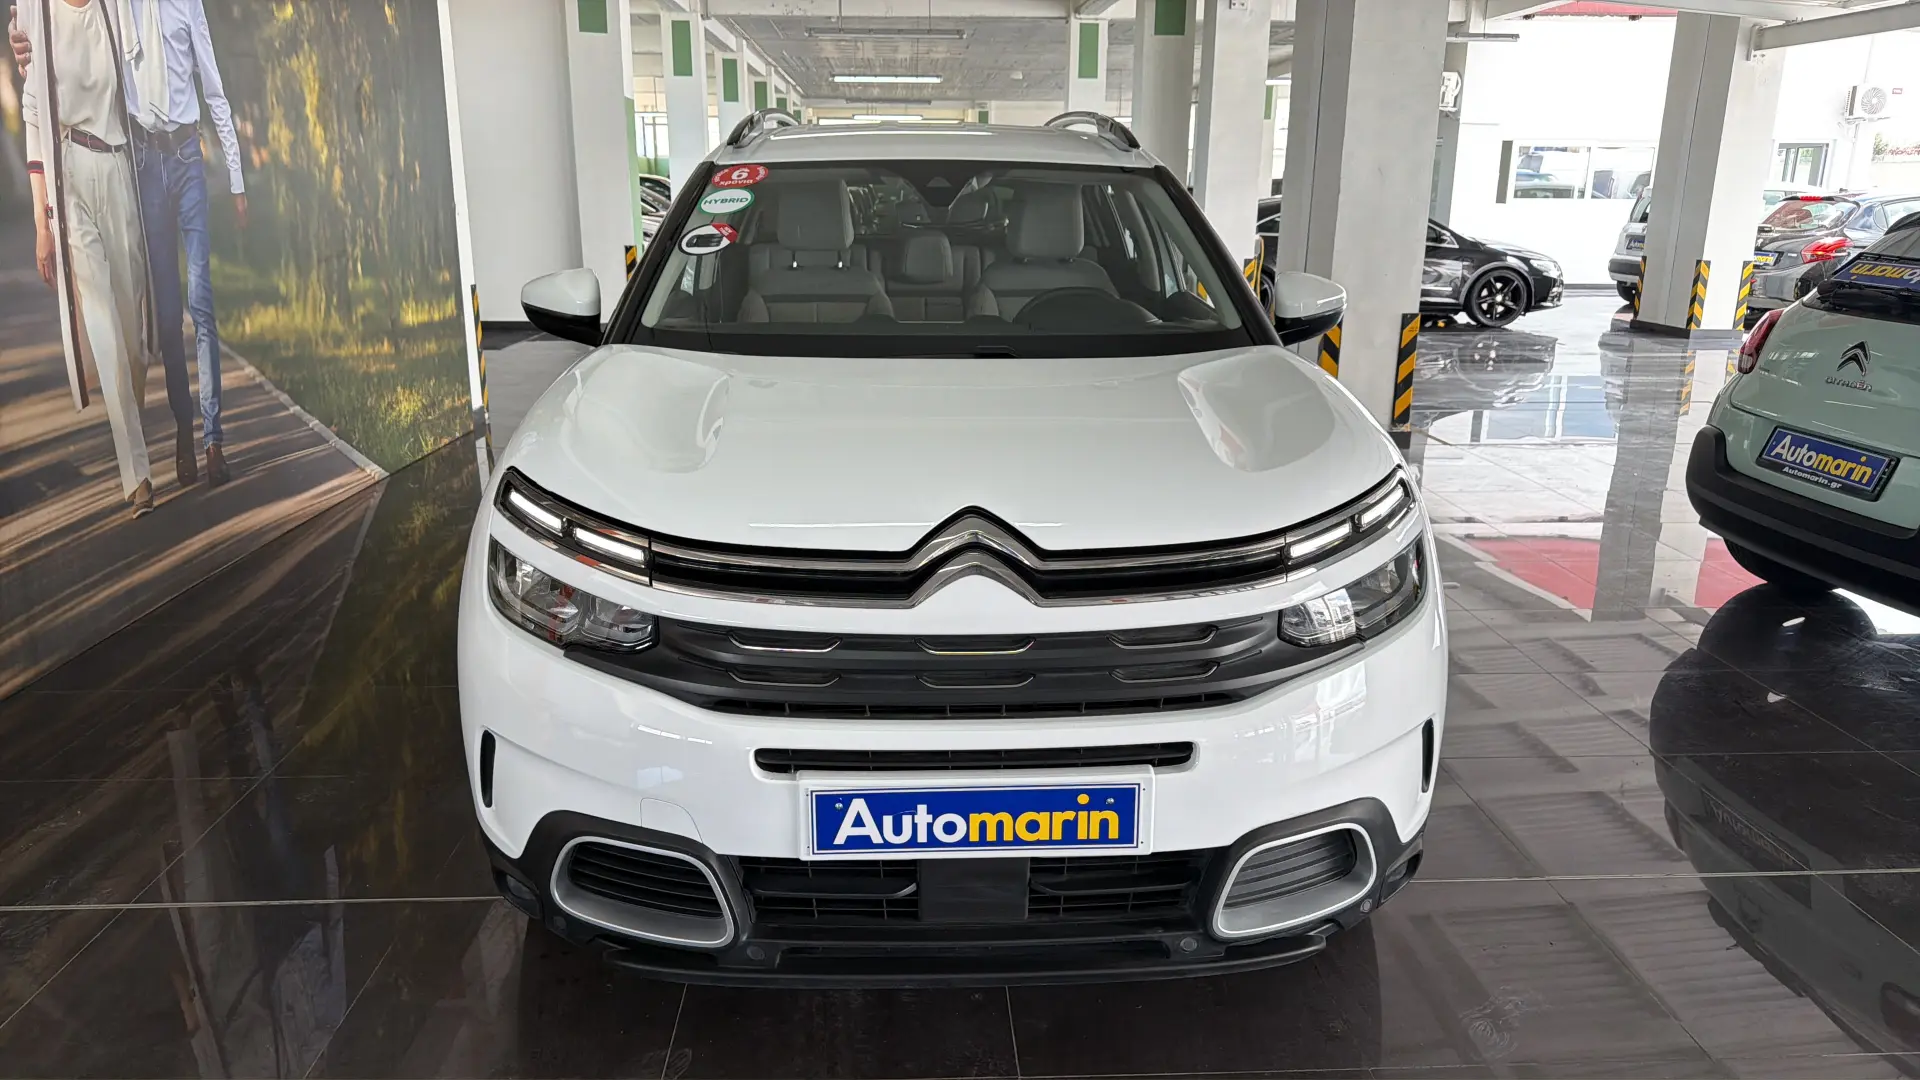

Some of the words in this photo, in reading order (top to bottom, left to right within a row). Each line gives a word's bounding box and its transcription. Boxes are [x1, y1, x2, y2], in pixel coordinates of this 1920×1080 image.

[731, 167, 750, 180] 6
[703, 197, 749, 205] HYBRID
[1771, 434, 1872, 484] Automarin
[1782, 466, 1842, 489] Automarin.gr
[833, 794, 1119, 845] Automarin
